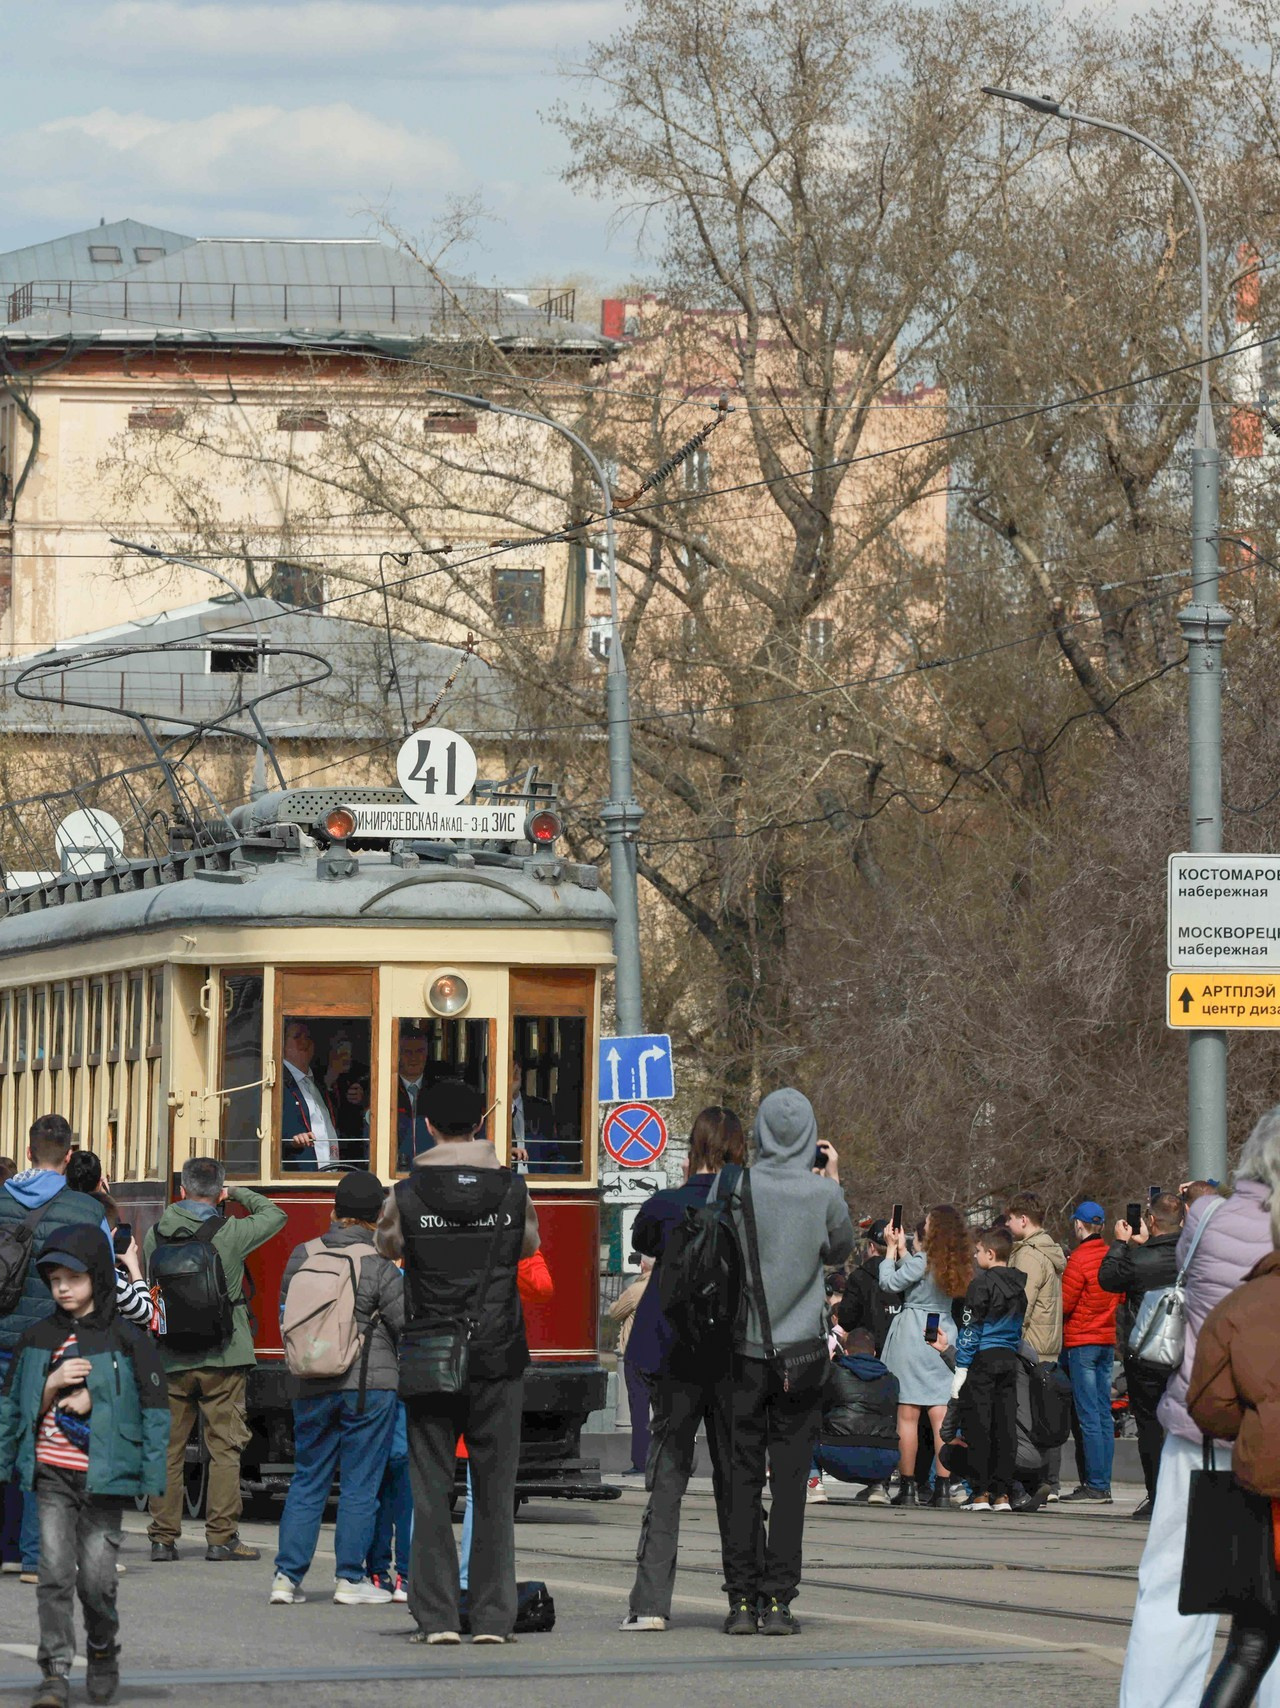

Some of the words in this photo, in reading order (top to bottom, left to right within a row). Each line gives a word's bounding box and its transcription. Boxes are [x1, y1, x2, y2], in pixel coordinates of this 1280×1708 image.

[408, 739, 458, 795] 41
[353, 810, 438, 831] ИМИРЯЗЕВСКАЯ
[492, 812, 516, 832] ЗИС
[1179, 885, 1268, 899] набережная
[1179, 943, 1268, 957] набережная
[1202, 984, 1276, 998] АРТПЛЭЙ
[1202, 1004, 1245, 1017] центр
